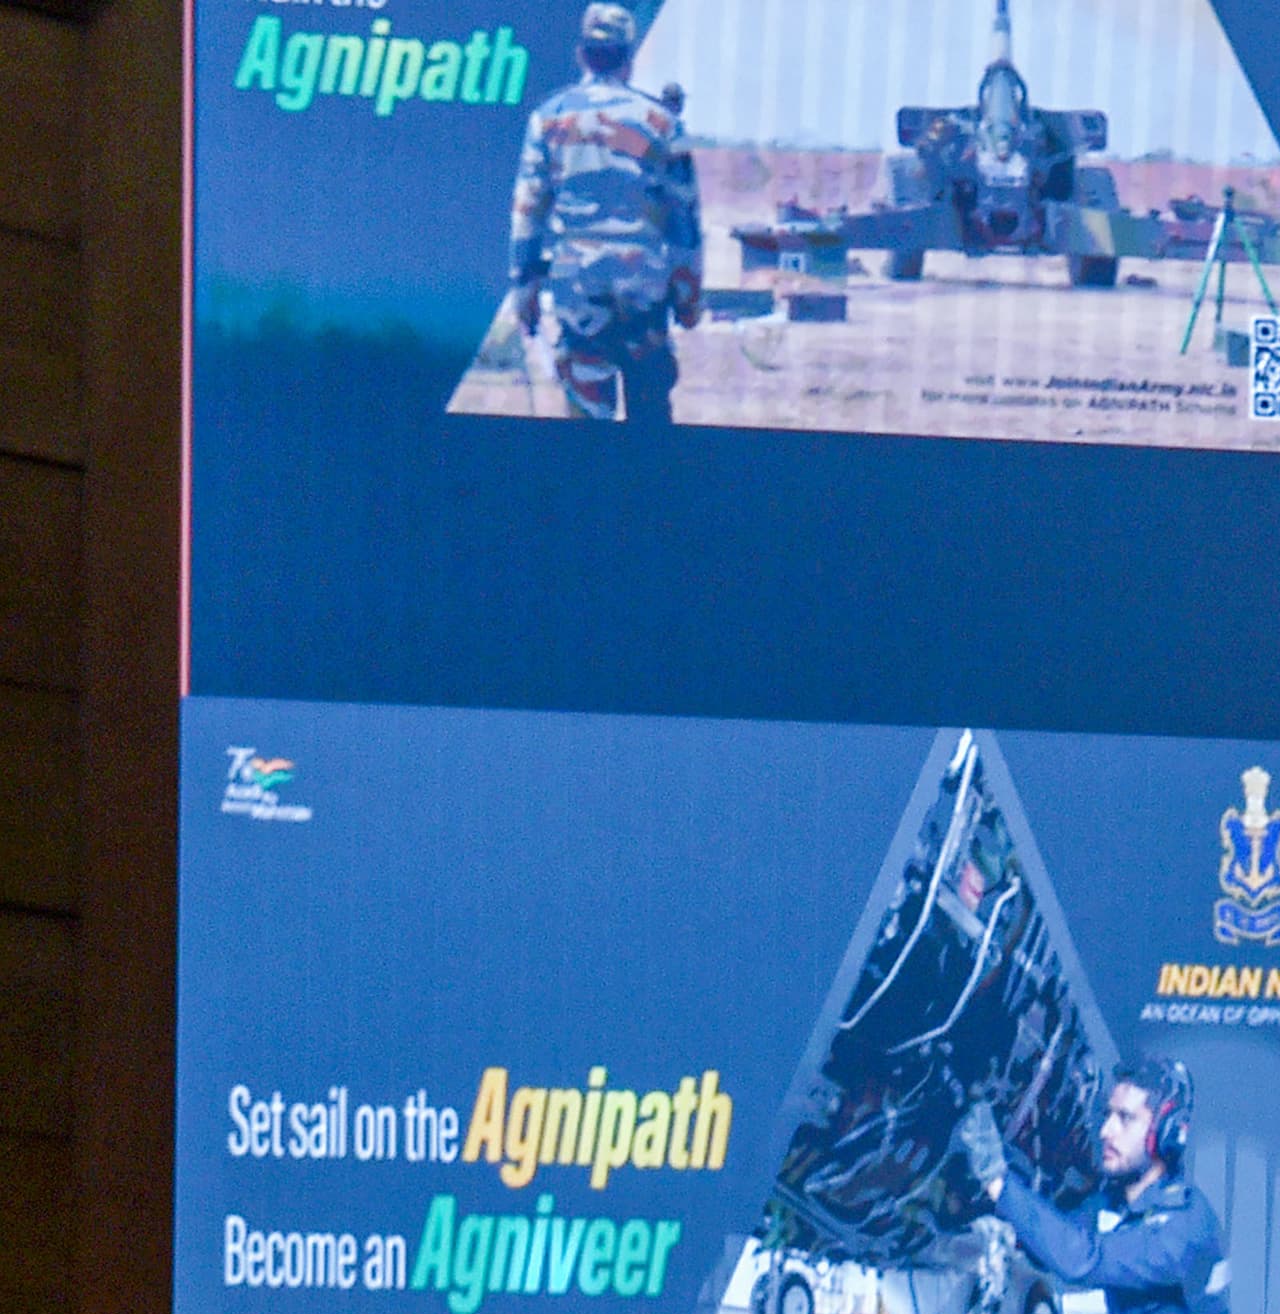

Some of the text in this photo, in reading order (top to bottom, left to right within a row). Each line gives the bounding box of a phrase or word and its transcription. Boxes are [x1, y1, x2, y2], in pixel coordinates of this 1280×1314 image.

[235, 15, 531, 116] Agnipath
[1139, 1003, 1164, 1021] AN
[1166, 1004, 1221, 1023] OCEAN
[1157, 963, 1262, 998] INDIAN
[228, 1066, 732, 1190] Set sail on the Agnipath
[223, 1214, 356, 1289] Become
[363, 1234, 406, 1290] an
